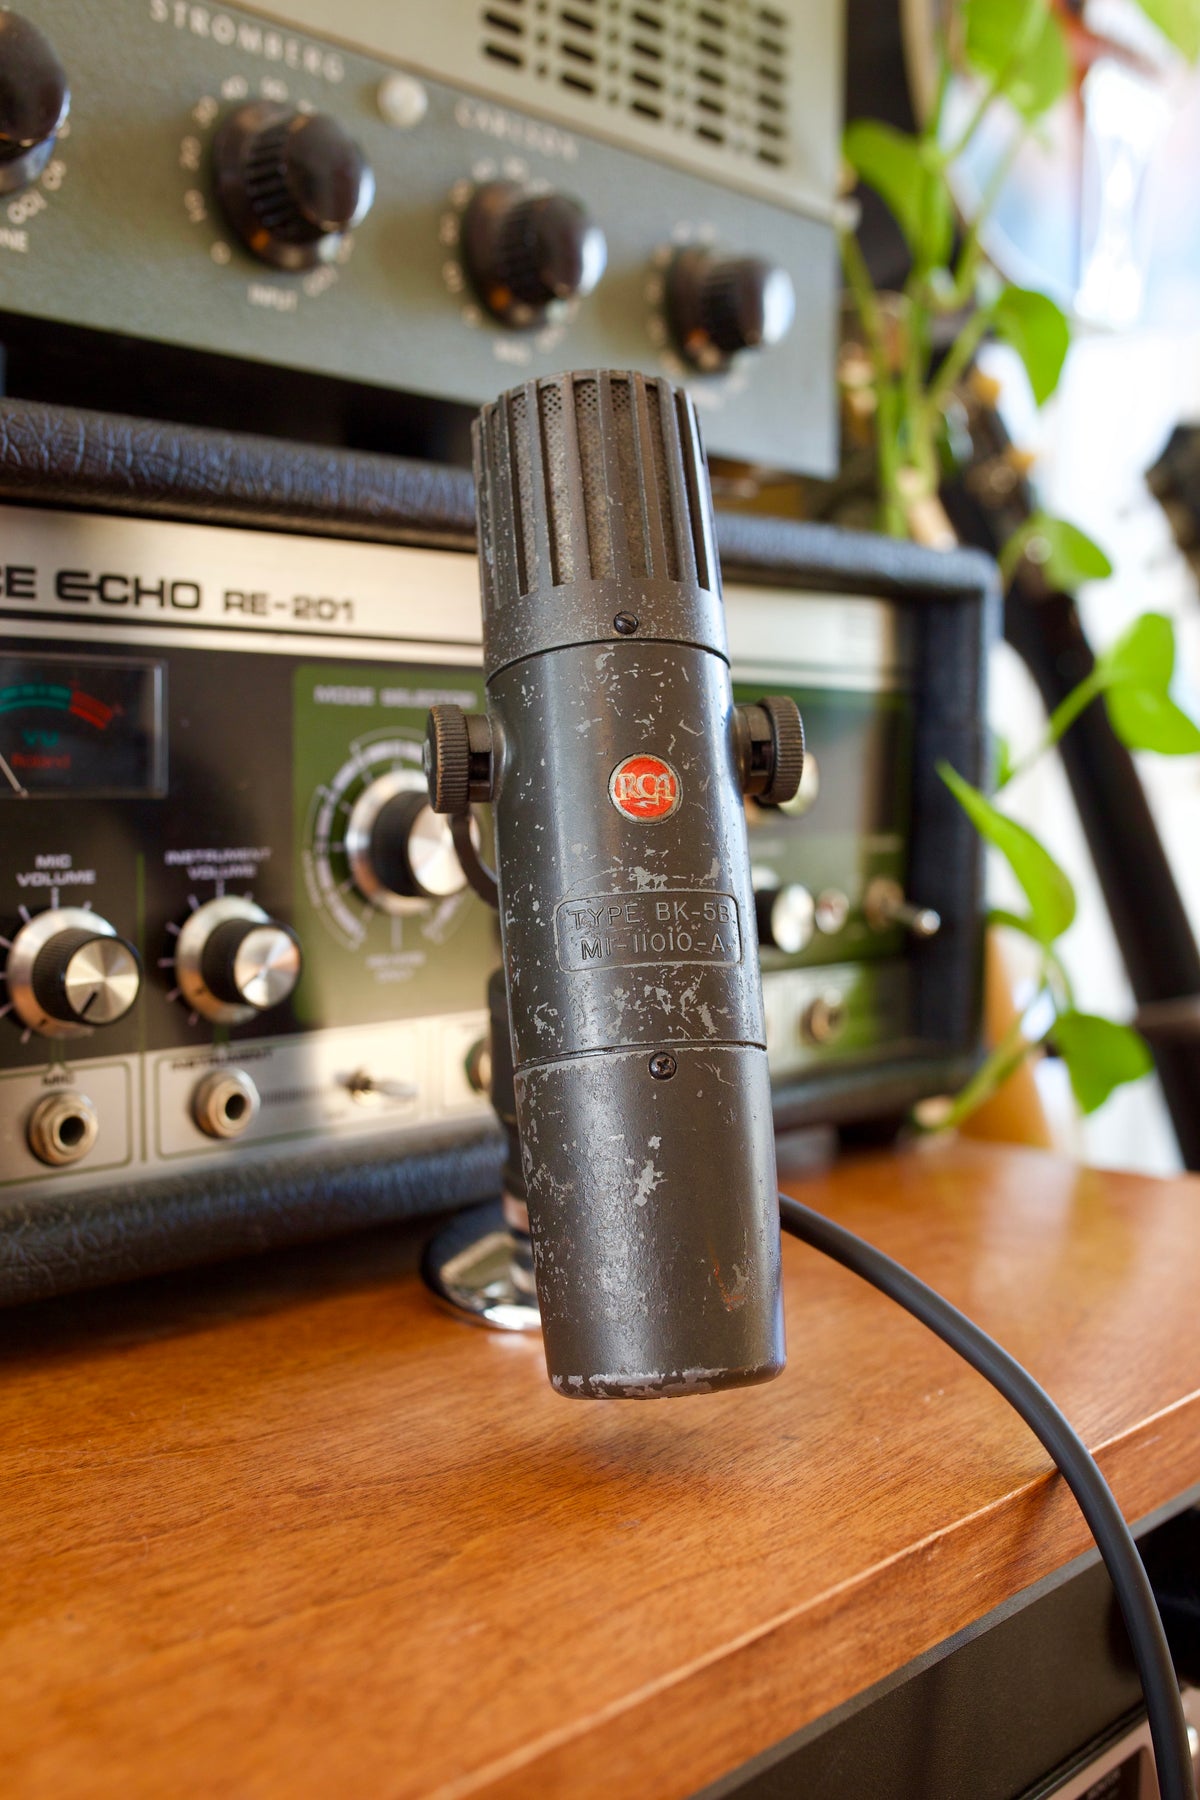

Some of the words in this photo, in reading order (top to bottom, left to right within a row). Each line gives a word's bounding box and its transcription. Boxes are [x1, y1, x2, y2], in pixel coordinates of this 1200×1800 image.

[149, 0, 345, 84] STROMBERG
[55, 570, 202, 612] ECHO
[223, 590, 355, 622] RE-201
[617, 772, 676, 805] RCA
[35, 854, 72, 869] MIC
[187, 864, 257, 881] VOLUME
[16, 870, 96, 887] VOLUME
[570, 902, 641, 930] TYPE
[656, 901, 731, 924] BK-5B
